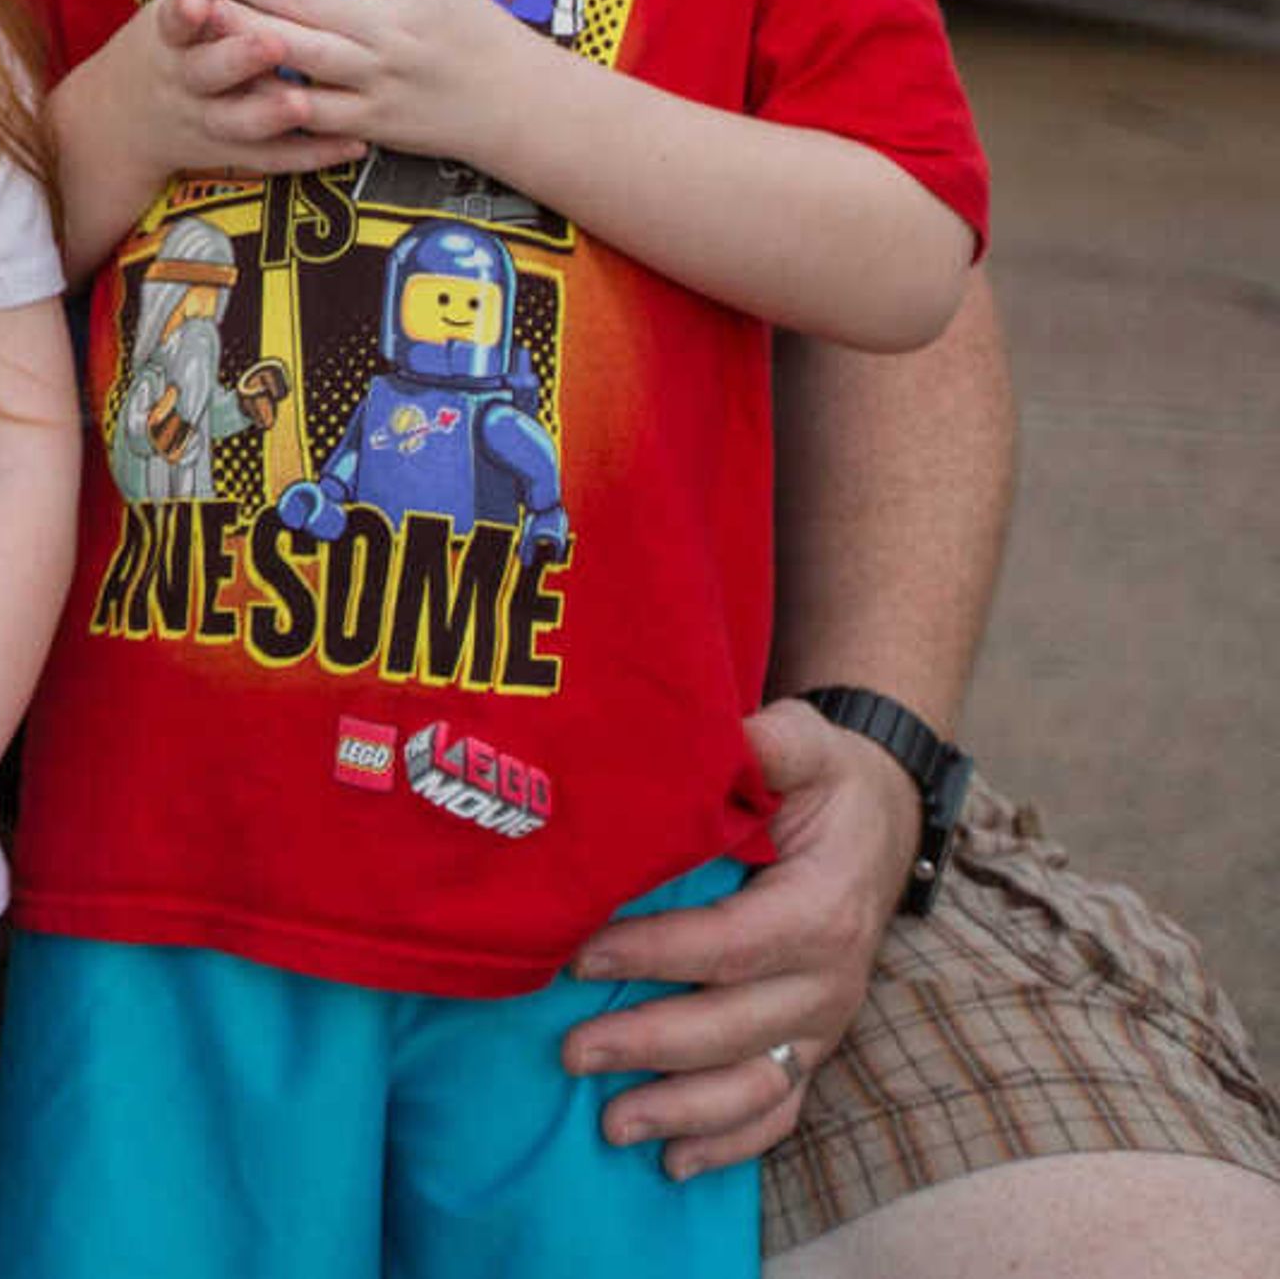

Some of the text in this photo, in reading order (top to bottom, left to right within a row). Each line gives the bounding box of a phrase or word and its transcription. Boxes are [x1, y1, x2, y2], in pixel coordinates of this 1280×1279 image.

[260, 161, 357, 267] IS
[90, 500, 575, 695] AWESOME
[340, 738, 391, 770] LEGO
[435, 720, 551, 817] LEGO
[412, 768, 547, 840] MOVIE
